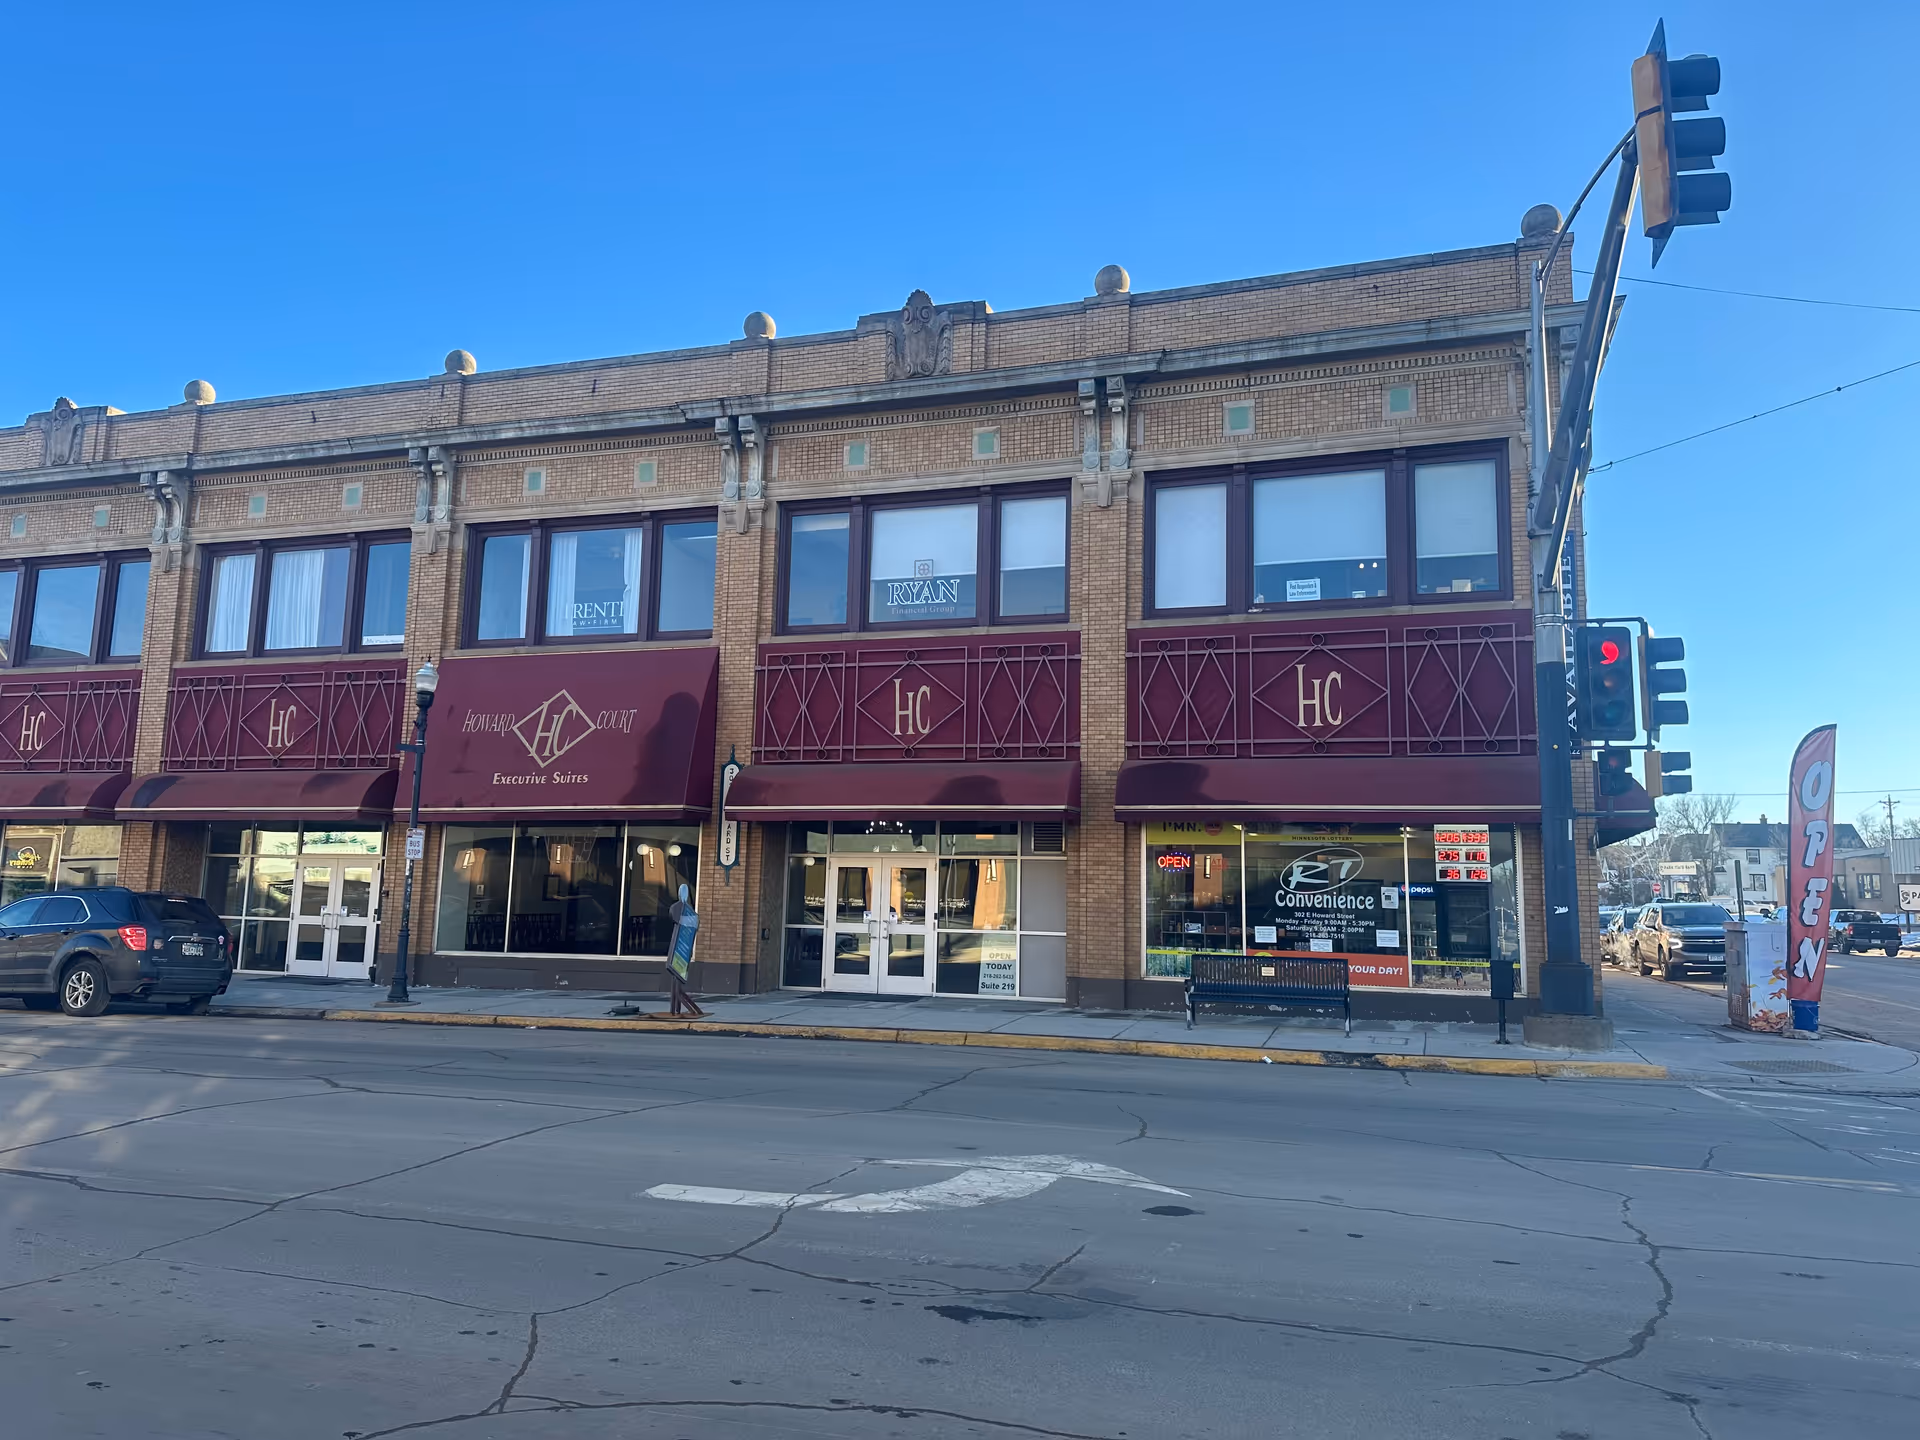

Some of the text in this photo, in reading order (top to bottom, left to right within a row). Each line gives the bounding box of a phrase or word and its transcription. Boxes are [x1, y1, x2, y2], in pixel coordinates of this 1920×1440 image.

[887, 579, 960, 606] RYAN
[891, 605, 955, 615] Financial Group
[893, 678, 931, 736] HC
[1295, 664, 1342, 727] HC
[18, 705, 46, 752] HC
[266, 698, 297, 749] HC
[462, 709, 516, 737] HOWARD
[597, 709, 638, 734] COURT
[1158, 856, 1190, 868] OPEN
[1288, 858, 1361, 889] RT
[1793, 760, 1832, 981] OPEN
[1275, 890, 1374, 910] Convenience
[1411, 886, 1434, 894] pepsi
[1348, 964, 1403, 976] YOUR DAY!
